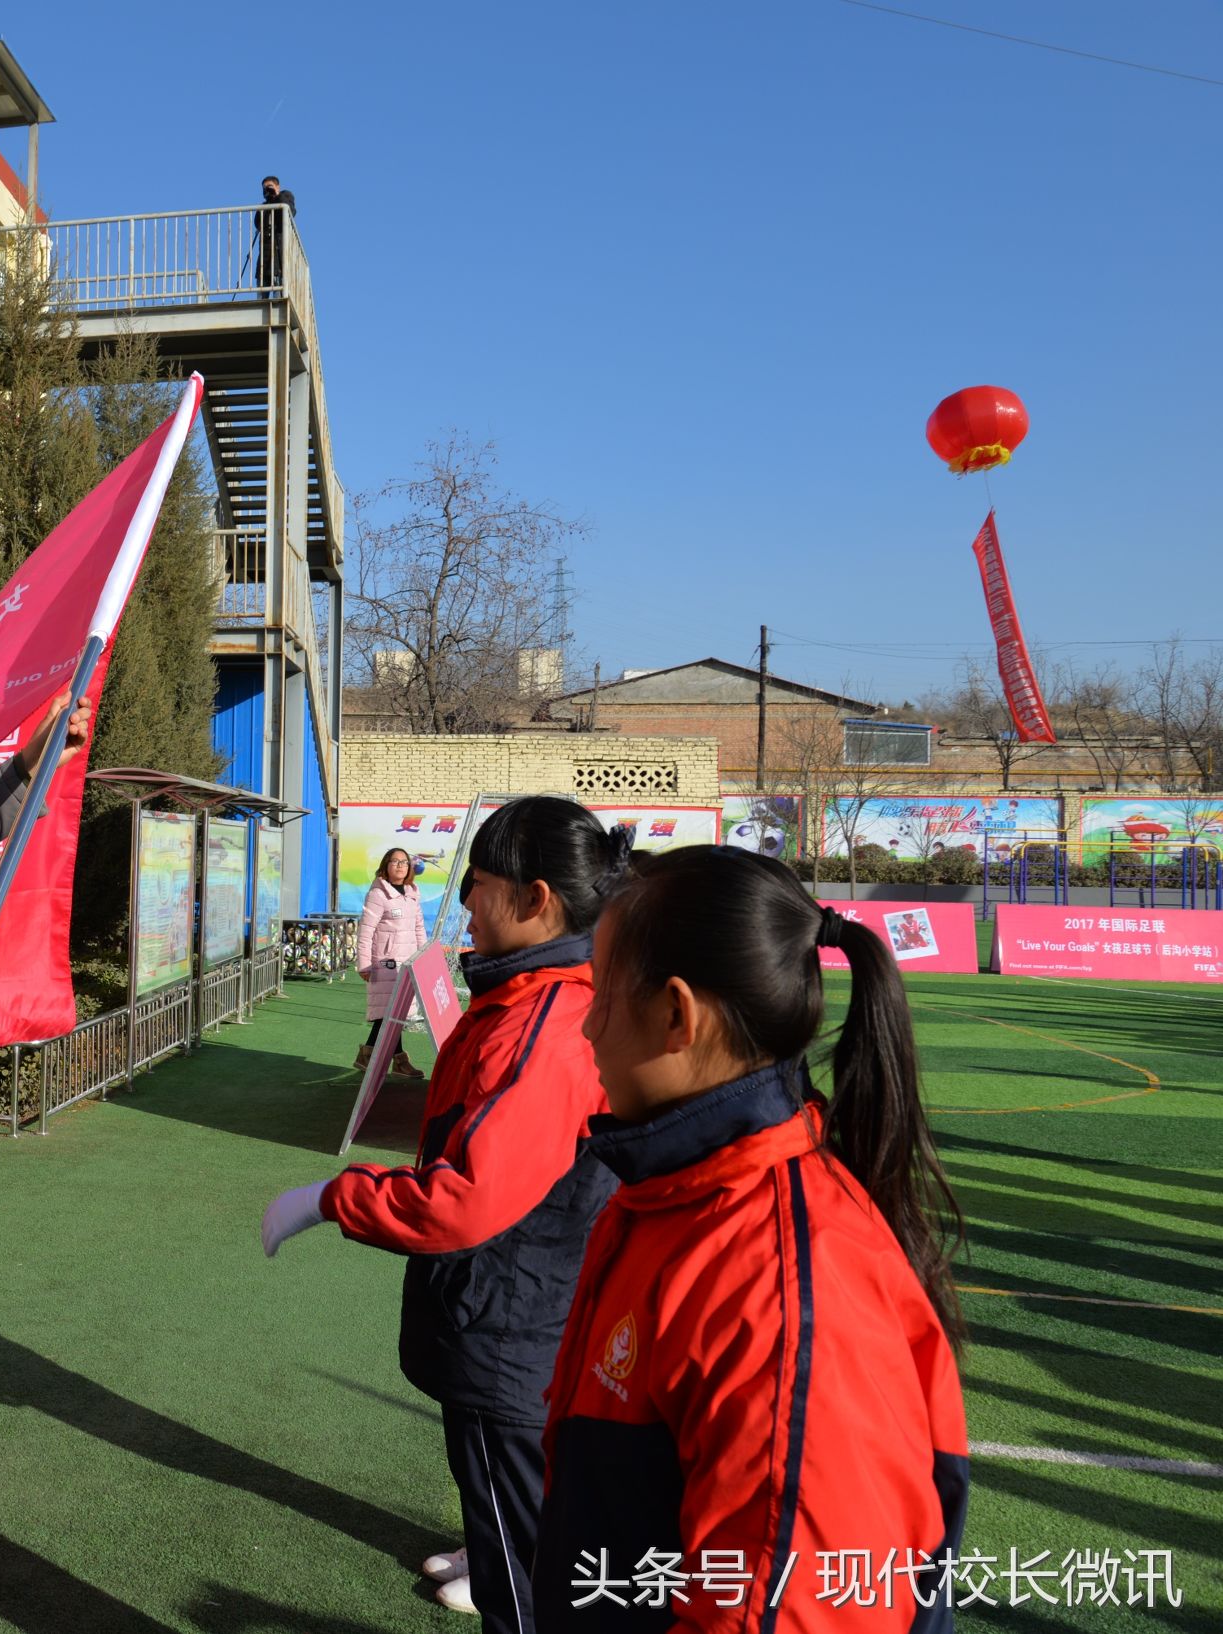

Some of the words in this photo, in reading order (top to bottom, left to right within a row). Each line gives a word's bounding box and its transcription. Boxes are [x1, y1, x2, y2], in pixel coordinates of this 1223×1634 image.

[1064, 918, 1094, 930] 2017
[1098, 918, 1166, 933] 年国际足联
[1043, 941, 1065, 952] Your
[1194, 963, 1217, 972] FIFA
